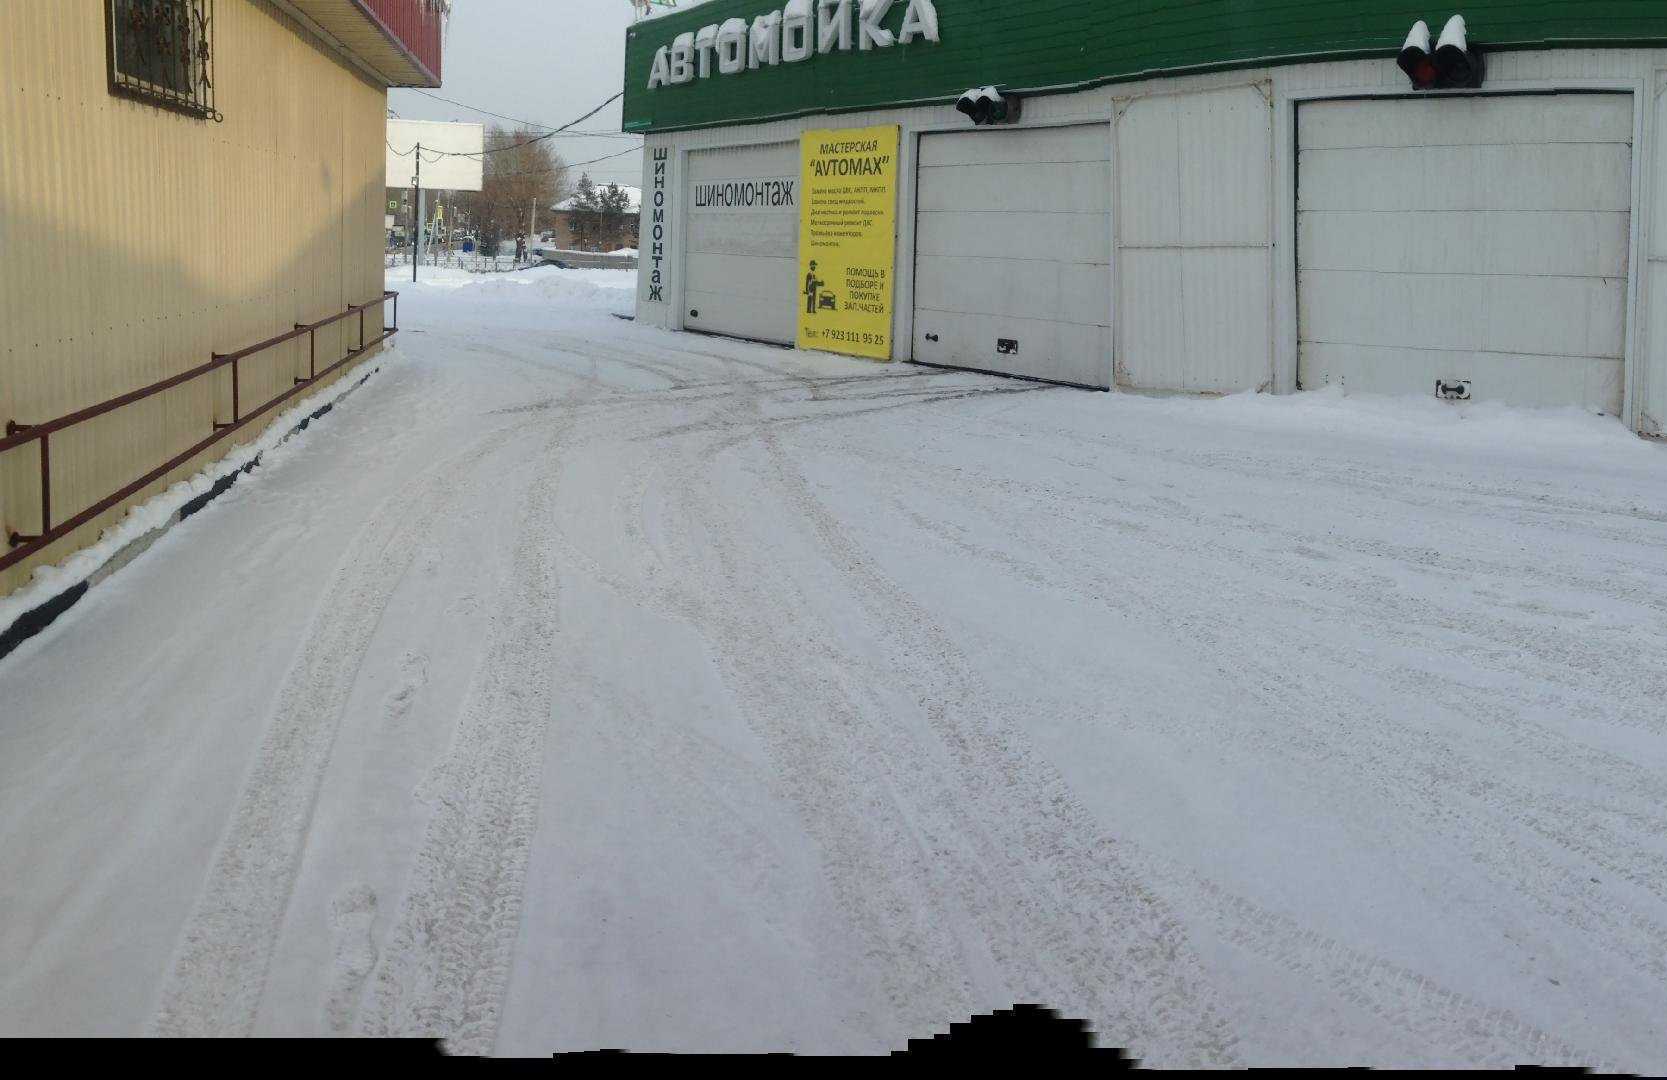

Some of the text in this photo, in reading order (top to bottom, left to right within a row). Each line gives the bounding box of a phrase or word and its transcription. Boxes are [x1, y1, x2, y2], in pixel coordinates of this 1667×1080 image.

[820, 140, 878, 155] МАСТЕРСКАЯ
[846, 279, 878, 290] ПОДБОРЕ
[849, 290, 880, 301] ПОКУПКЕ
[831, 329, 845, 340] 923
[846, 331, 860, 343] 111
[874, 335, 884, 346] 25
